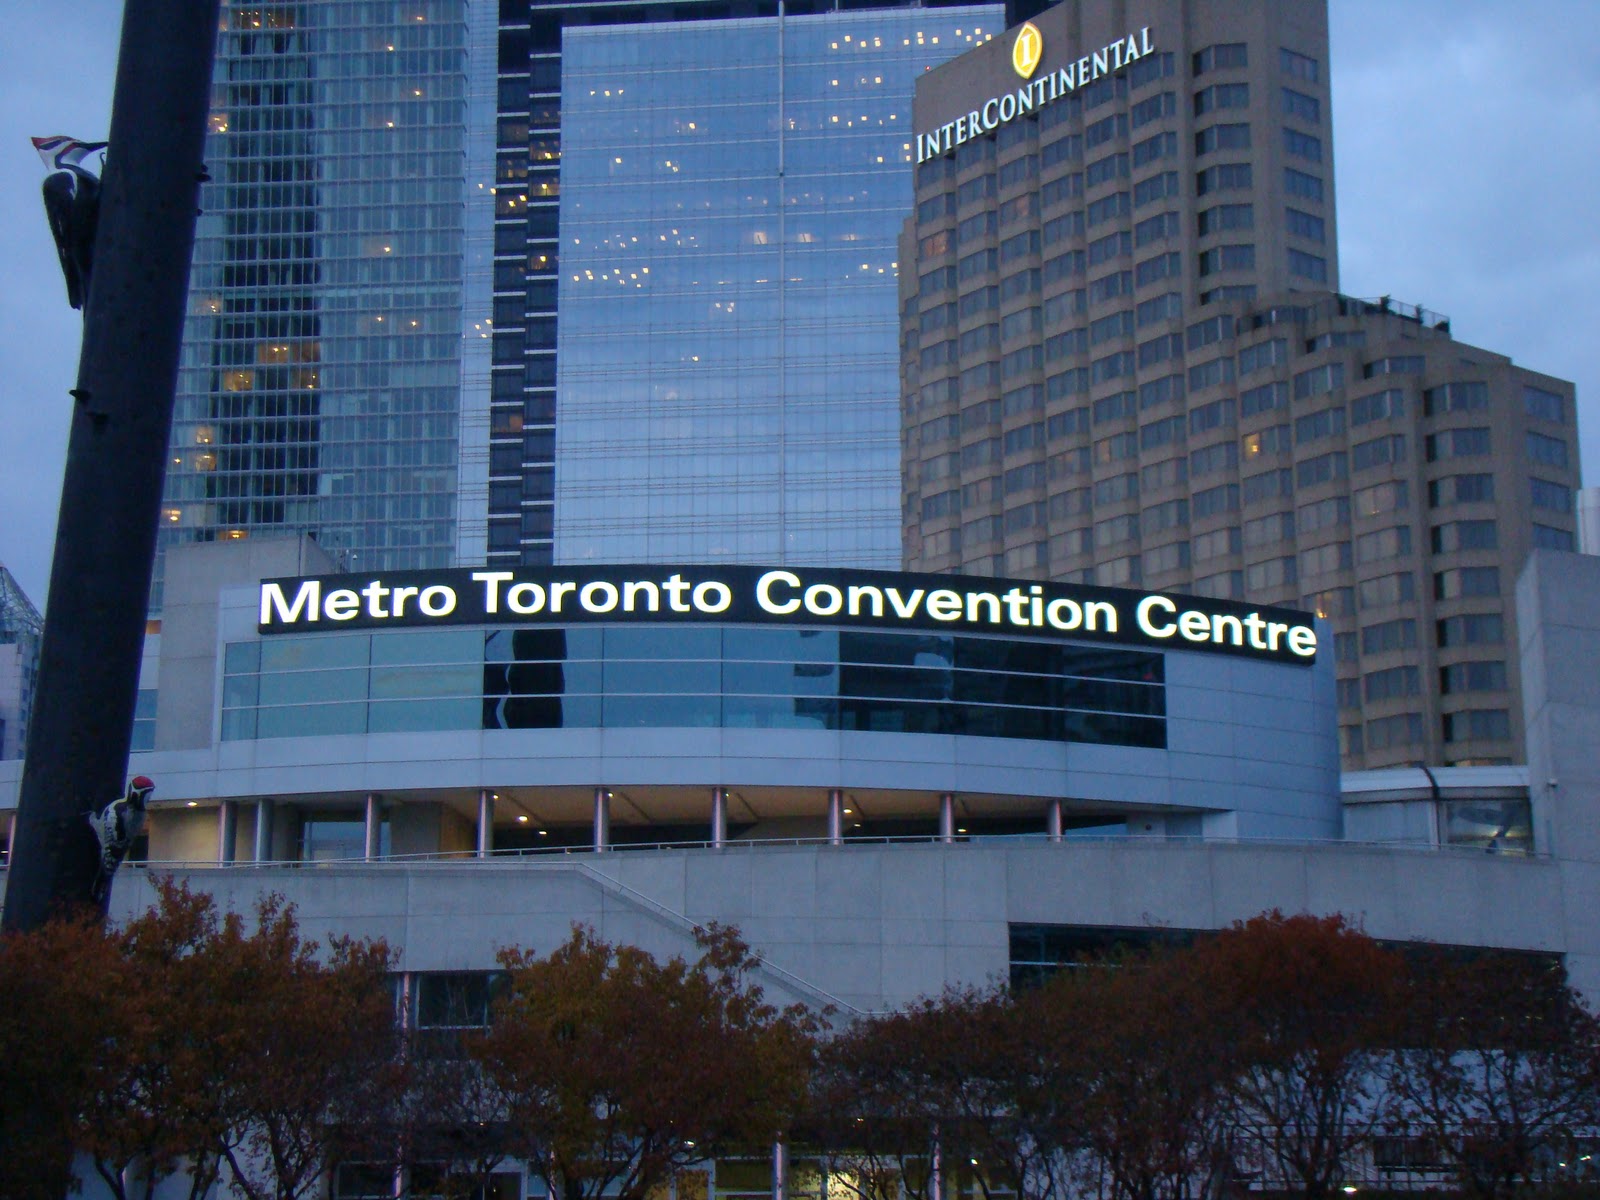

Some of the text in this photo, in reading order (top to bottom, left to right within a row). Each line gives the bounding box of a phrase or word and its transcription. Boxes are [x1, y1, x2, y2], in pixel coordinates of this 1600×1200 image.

[916, 26, 1155, 164] INTERCONTINENTAL
[260, 569, 1318, 657] Metro Toronto Convention Centre
